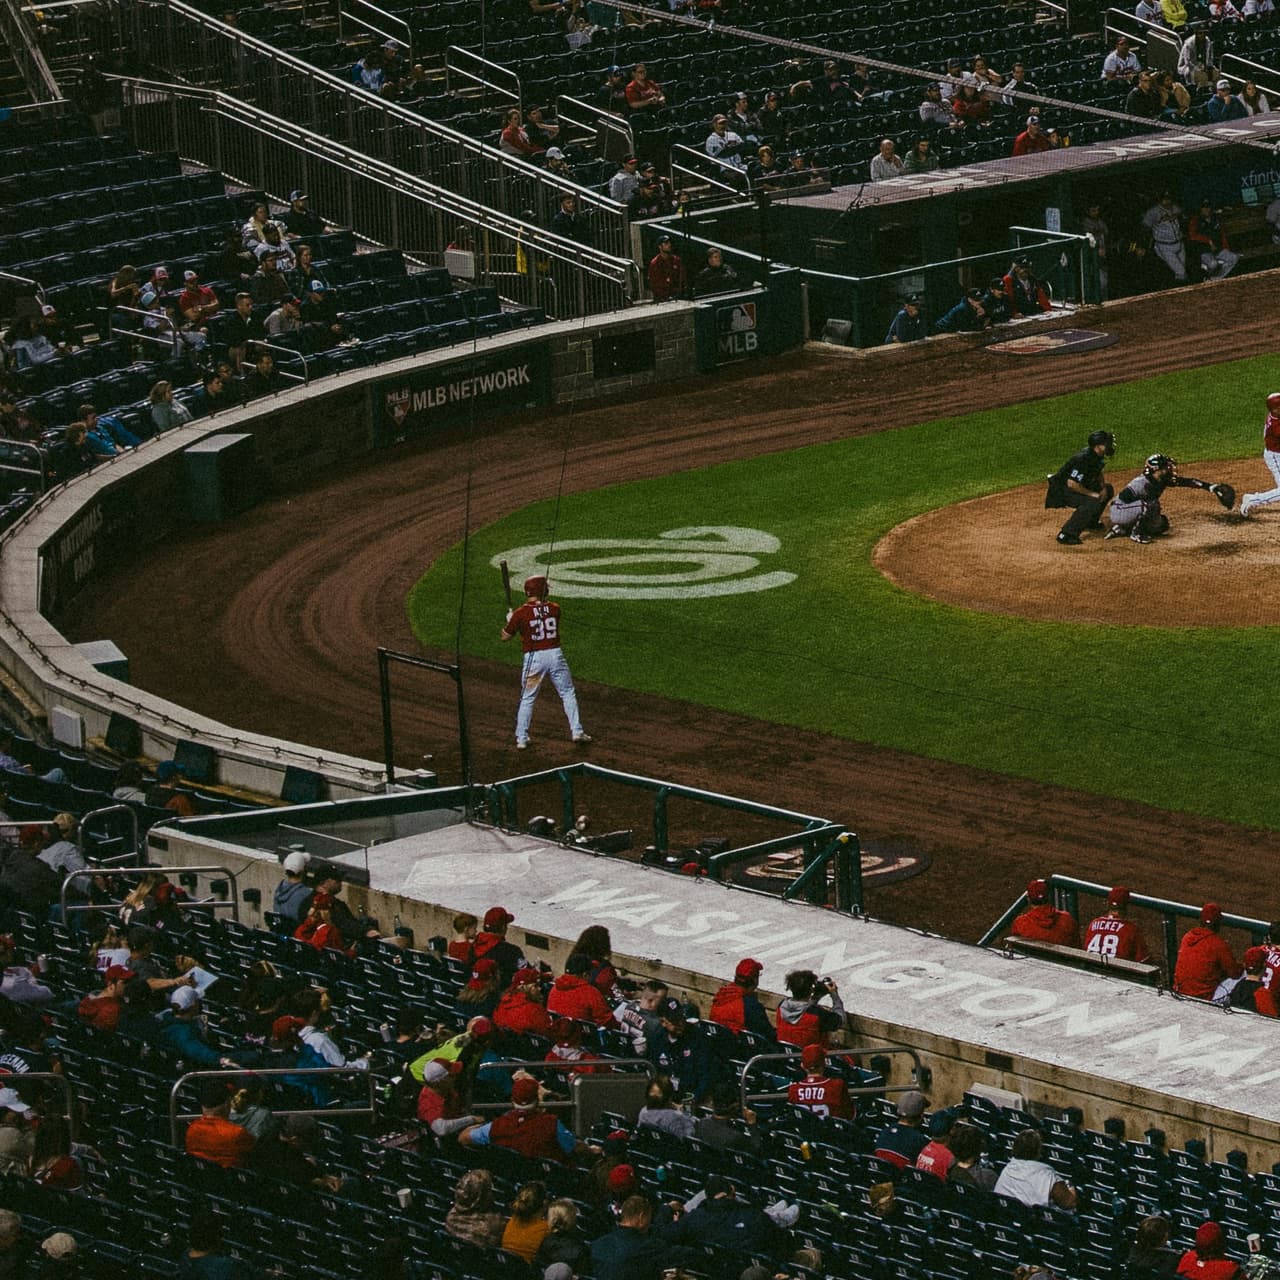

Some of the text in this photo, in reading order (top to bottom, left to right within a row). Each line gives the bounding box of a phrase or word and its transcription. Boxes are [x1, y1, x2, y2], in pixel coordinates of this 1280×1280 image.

[717, 331, 759, 353] MLB
[387, 388, 409, 403] MLB
[413, 389, 447, 412] MLB
[449, 363, 531, 401] NETWORK
[529, 617, 557, 640] 39
[1091, 920, 1125, 933] HICKEY
[1086, 934, 1119, 958] 48
[540, 877, 1140, 1042] WASHINGTON
[797, 1087, 825, 1100] SOTO
